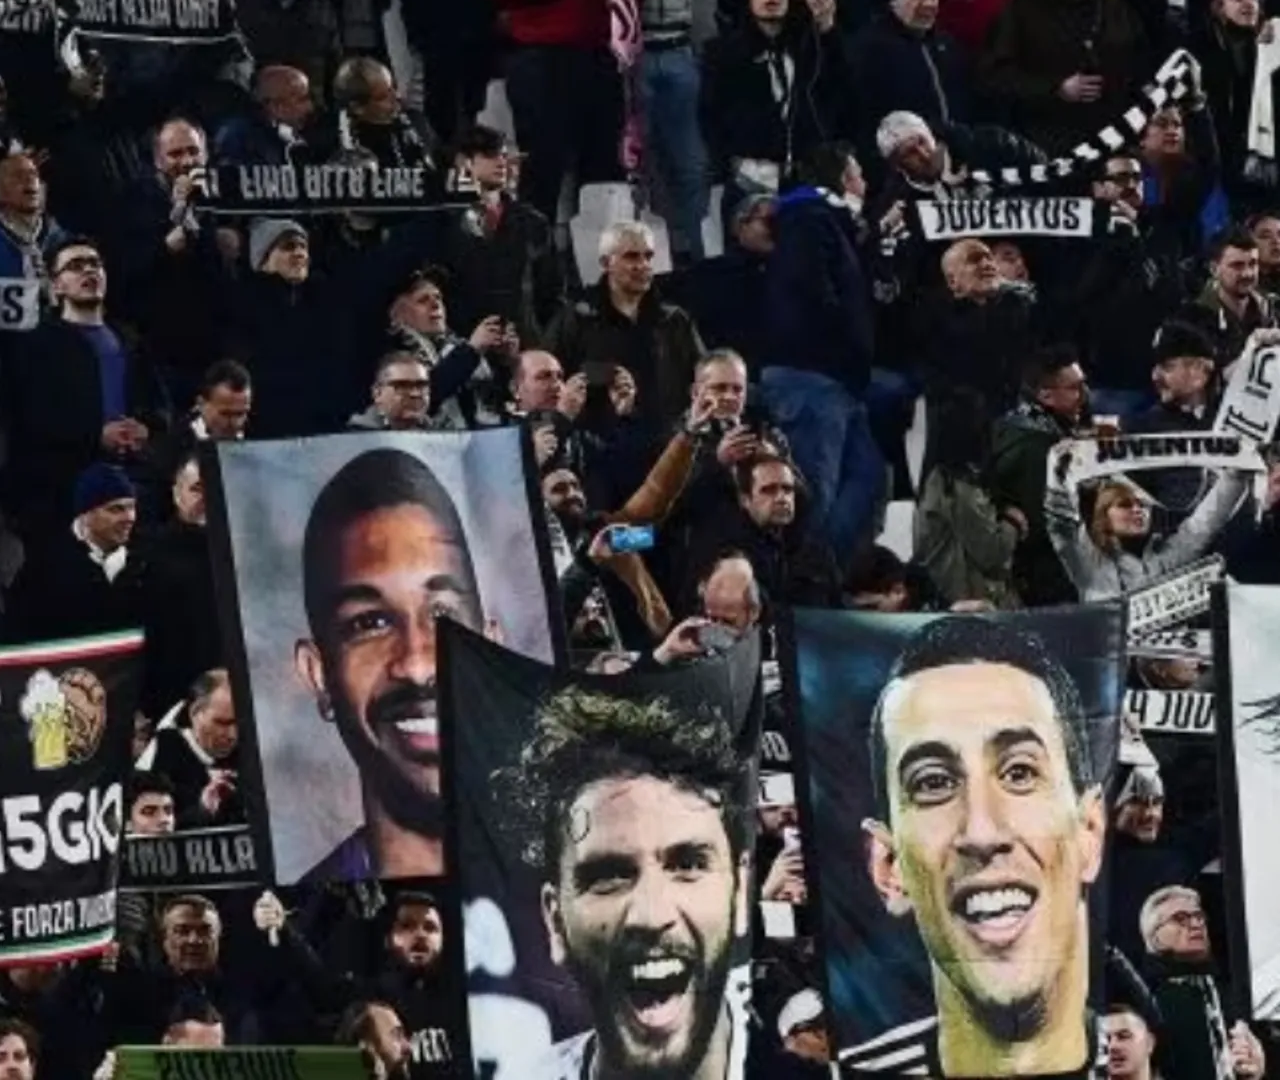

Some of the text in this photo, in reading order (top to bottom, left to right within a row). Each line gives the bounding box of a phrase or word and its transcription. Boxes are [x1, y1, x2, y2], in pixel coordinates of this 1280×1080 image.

[932, 202, 1082, 233] JUVENTUS
[1097, 434, 1244, 462] JUVENTUS
[186, 836, 258, 875] ALLA
[11, 904, 76, 939] FORZA
